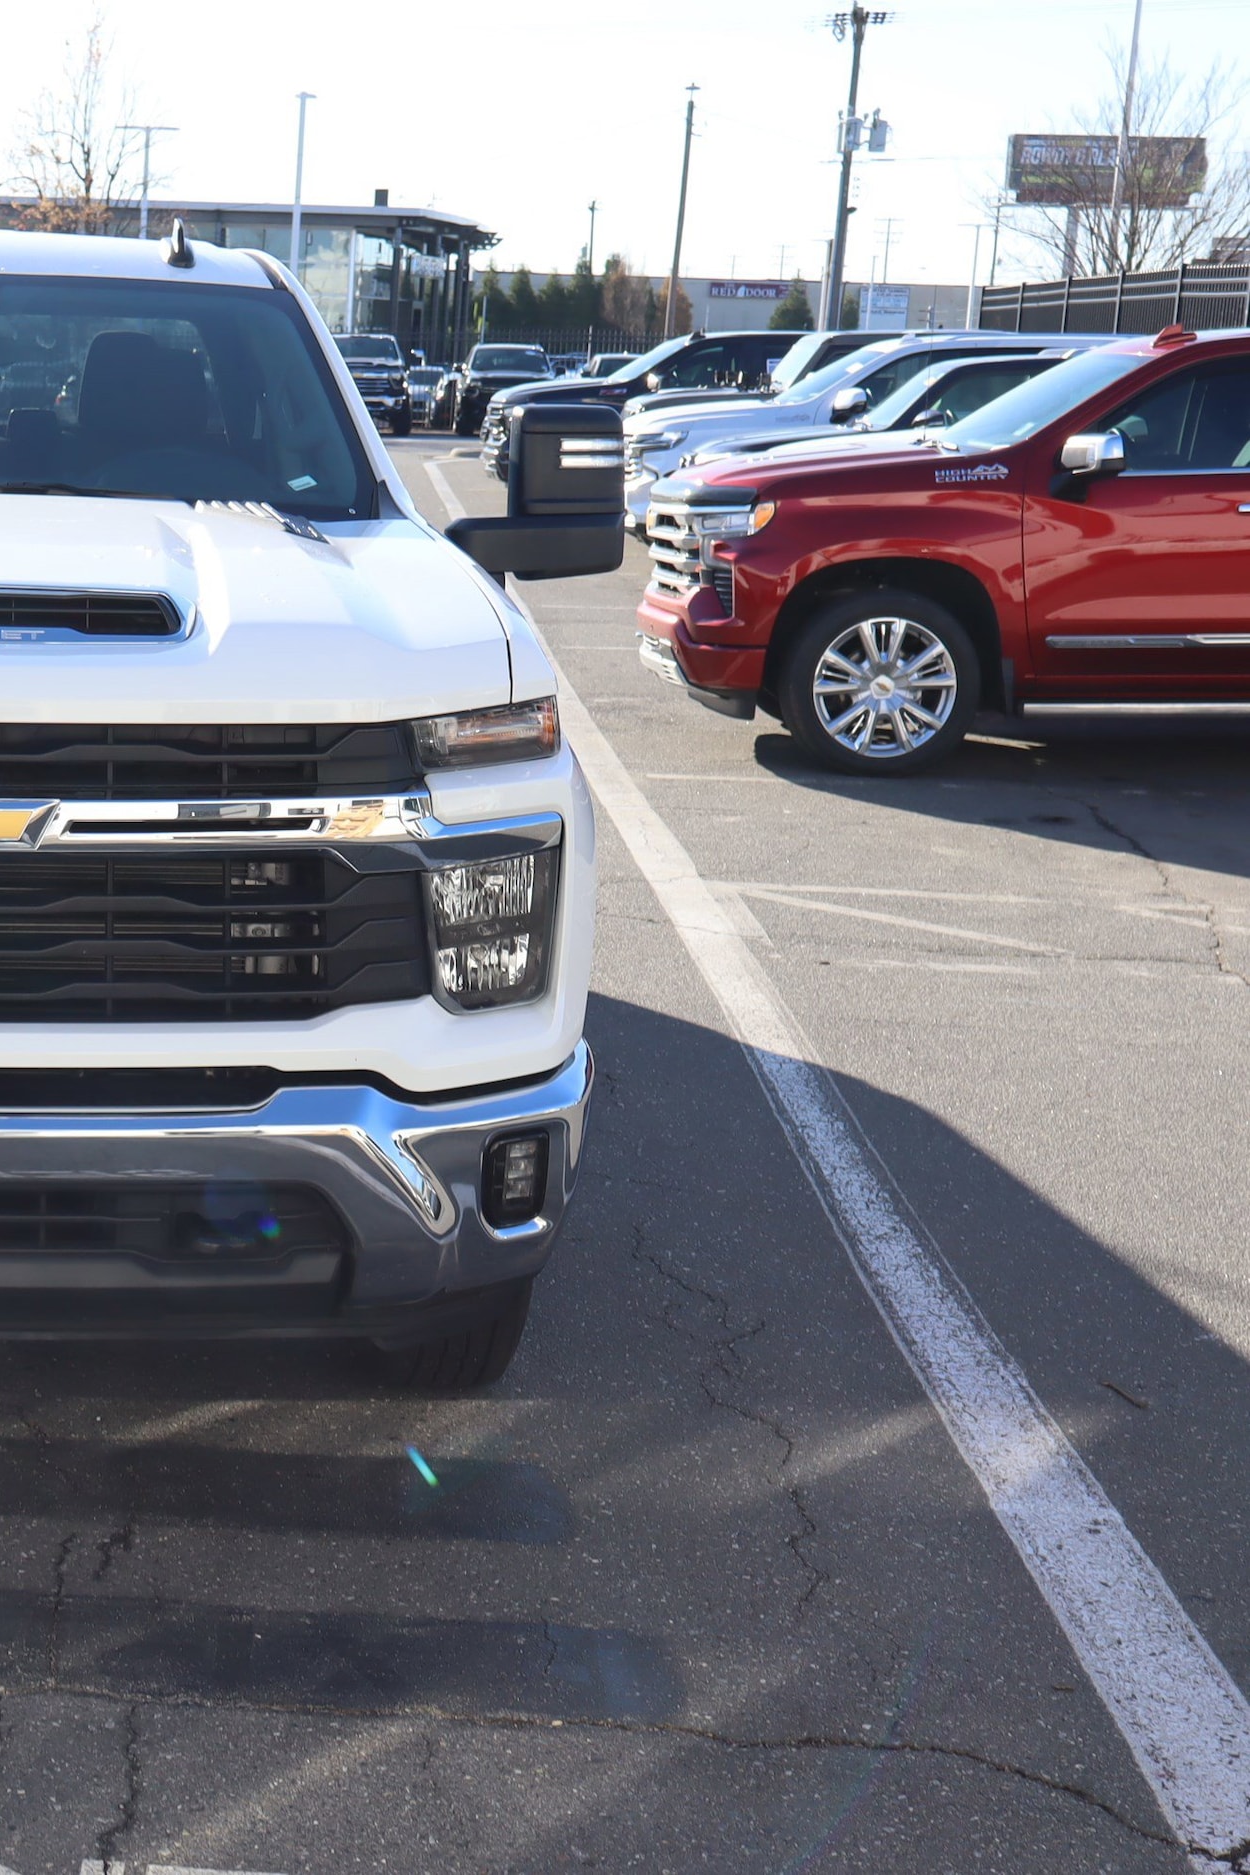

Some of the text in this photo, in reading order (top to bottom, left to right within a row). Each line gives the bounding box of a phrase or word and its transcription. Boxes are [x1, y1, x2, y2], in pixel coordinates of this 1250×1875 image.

[711, 287, 736, 297] RED
[746, 287, 776, 298] DOOR
[934, 468, 972, 477] HIGH
[934, 473, 1008, 483] COUNTRY
